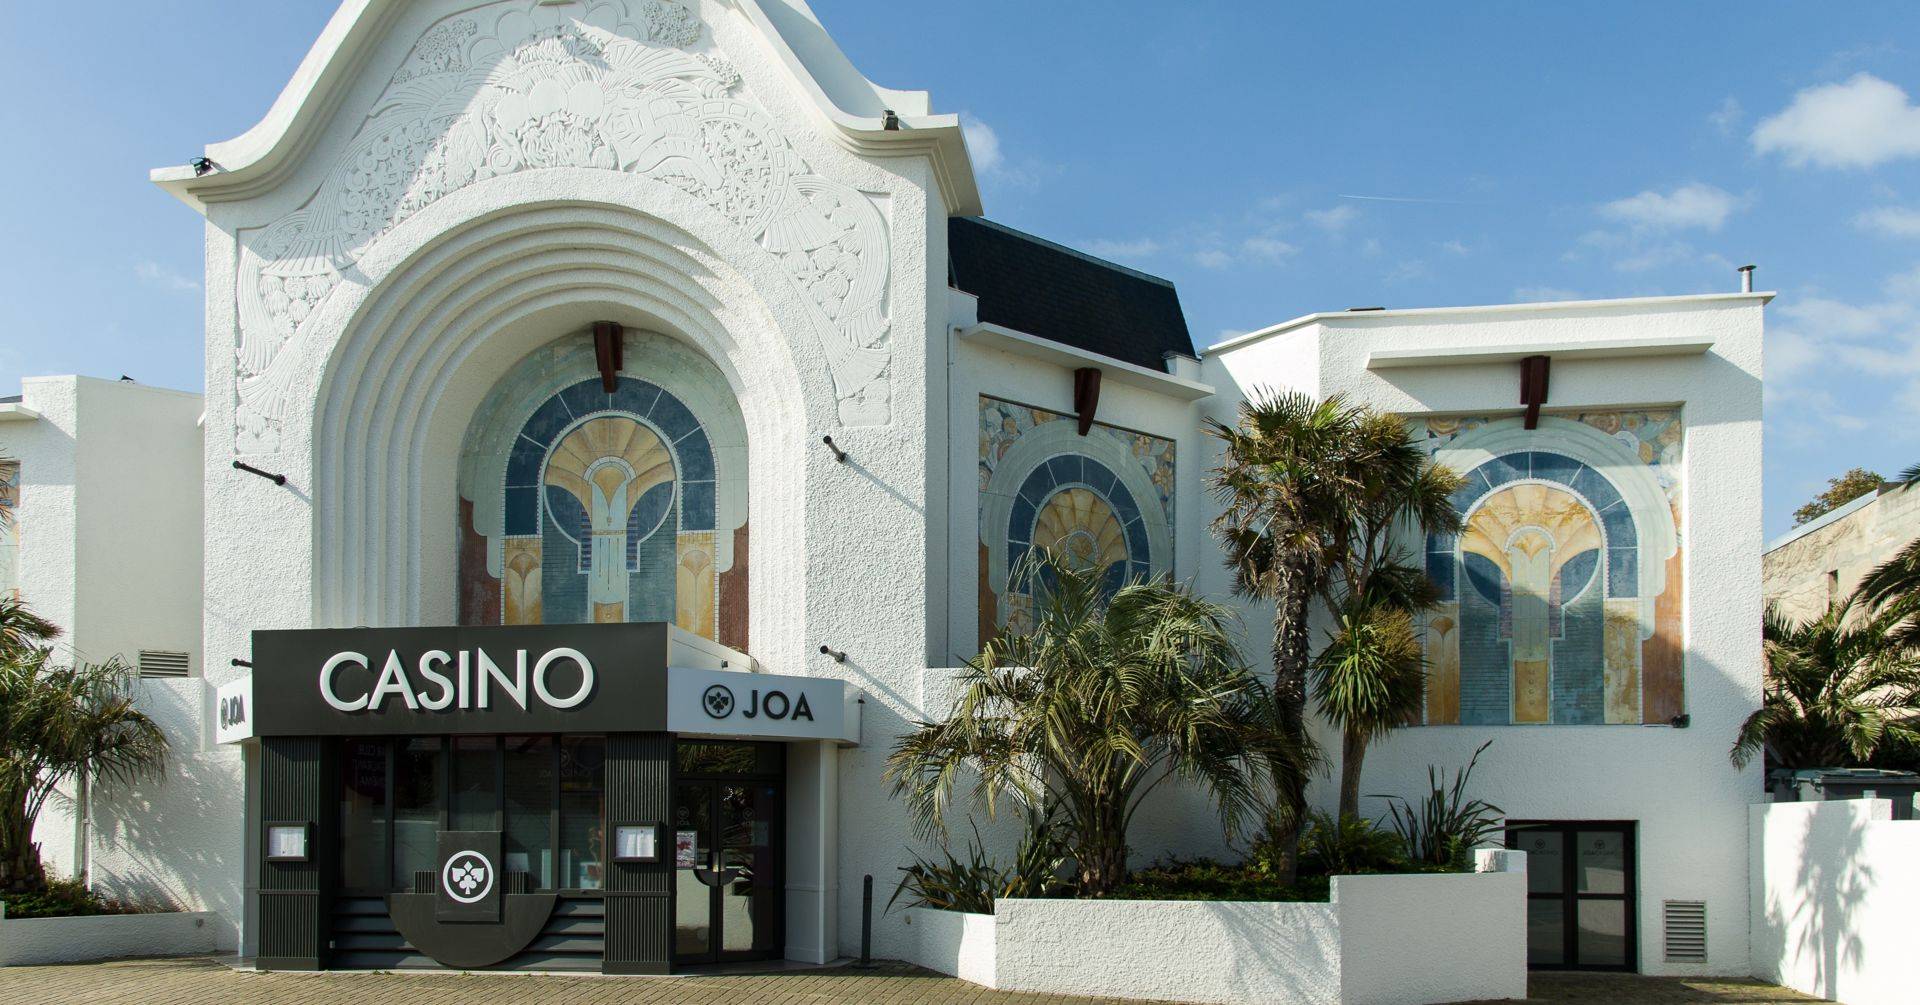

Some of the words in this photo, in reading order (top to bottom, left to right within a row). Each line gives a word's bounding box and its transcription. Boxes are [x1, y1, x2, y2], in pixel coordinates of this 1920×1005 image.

[319, 647, 594, 712] CASINO
[228, 694, 246, 726] JOA
[742, 689, 814, 721] JOA
